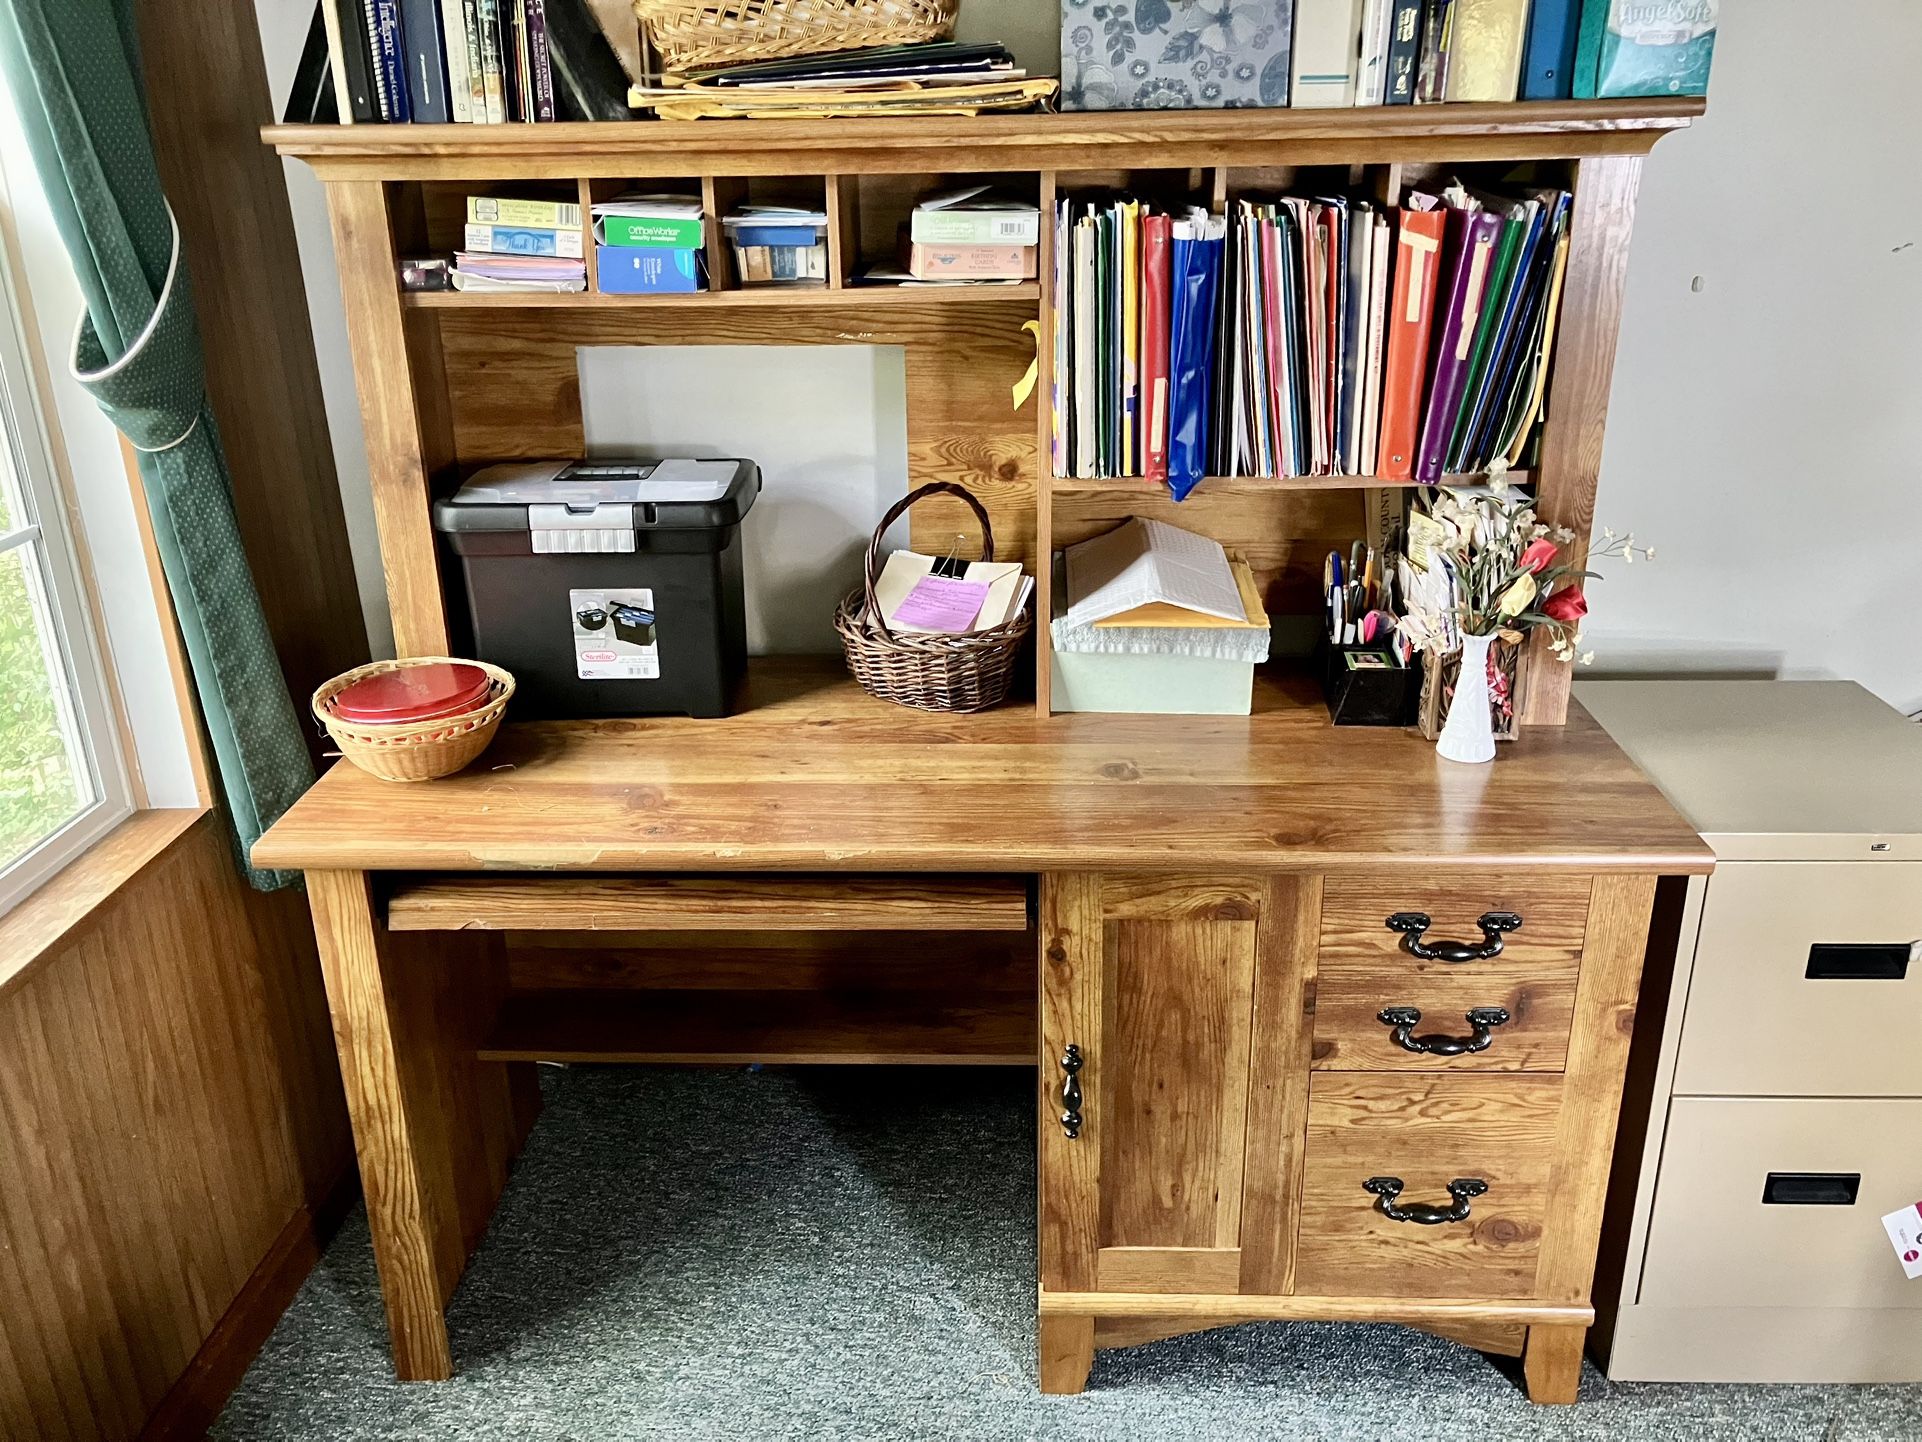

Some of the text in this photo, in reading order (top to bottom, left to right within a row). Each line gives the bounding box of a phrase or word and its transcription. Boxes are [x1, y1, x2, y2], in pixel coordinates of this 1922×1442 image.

[464, 2, 475, 32] Illinois
[1618, 1, 1713, 24] Angel Soft
[378, 2, 401, 117] Intelligence Daniel Goleman
[468, 44, 481, 78] Indiana
[539, 44, 547, 67] SECRET
[541, 67, 549, 90] POWER
[628, 225, 680, 236] OfficeWorker
